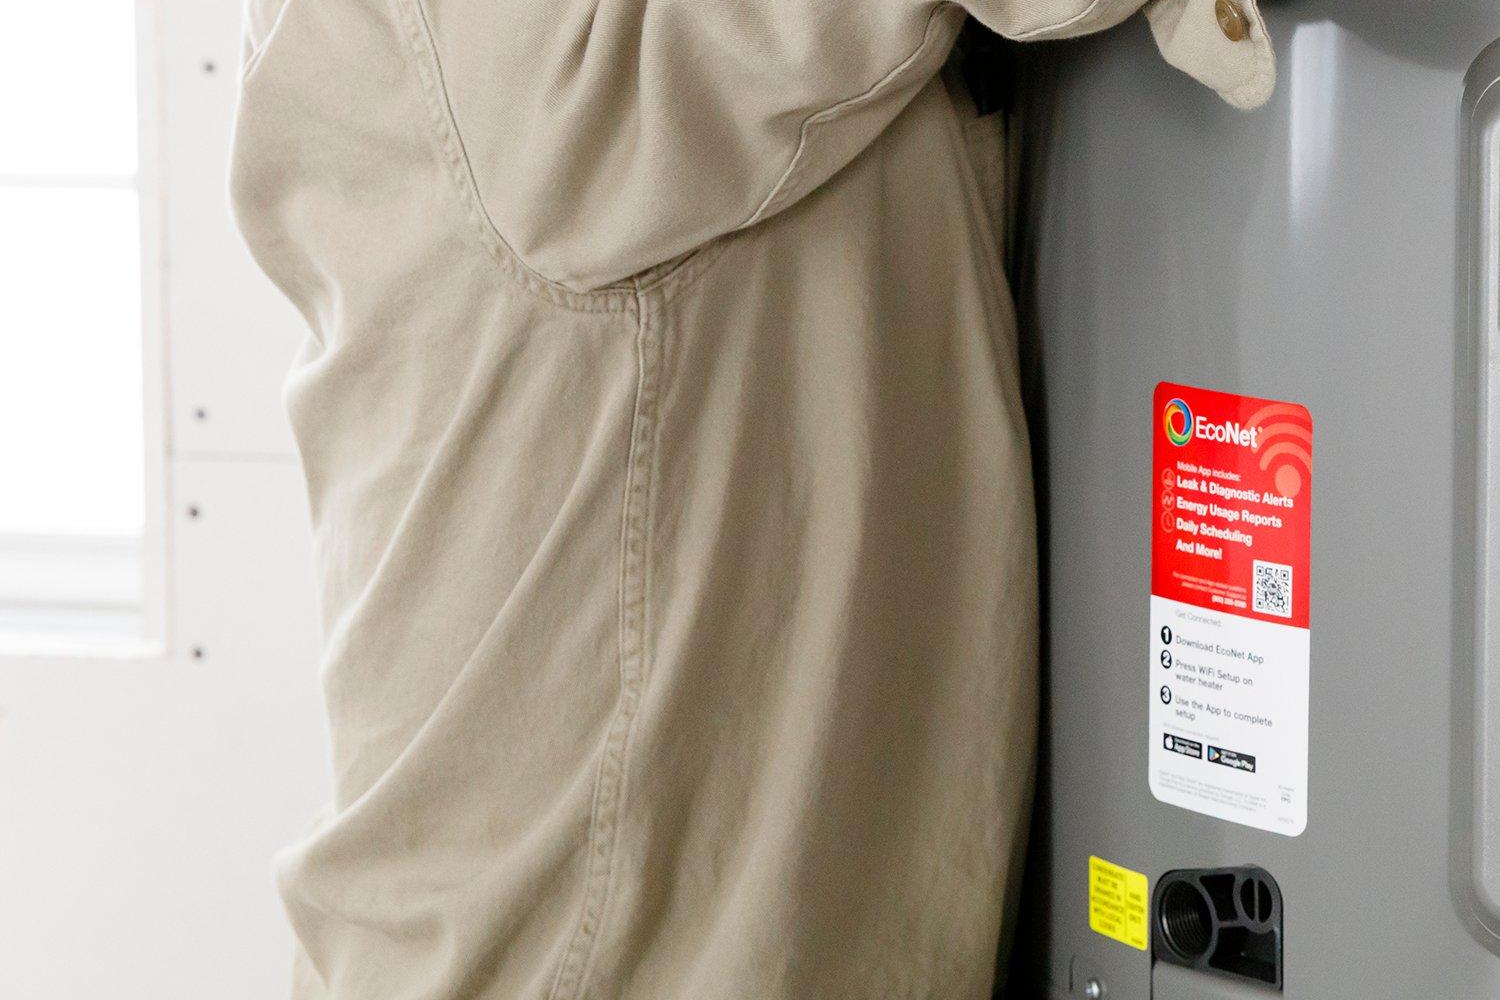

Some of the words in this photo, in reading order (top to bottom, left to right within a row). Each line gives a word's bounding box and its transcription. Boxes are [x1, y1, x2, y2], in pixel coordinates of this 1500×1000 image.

[1195, 416, 1258, 448] EcoNet
[1176, 461, 1198, 474] Mobile
[1199, 465, 1211, 477] App
[1176, 475, 1199, 491] Leak
[1200, 480, 1207, 492] &
[1209, 482, 1261, 502] Diagnostic
[1262, 492, 1294, 508] Alerts
[1176, 496, 1208, 516] Energy
[1209, 501, 1240, 521] Usage
[1241, 510, 1282, 528] Reports
[1176, 517, 1199, 536] Daily
[1199, 522, 1253, 547] Scheduling
[1176, 539, 1194, 553] And
[1195, 543, 1222, 560] More!
[1176, 635, 1213, 653] Download
[1216, 644, 1245, 660] EcoNet
[1247, 652, 1264, 664] App
[1175, 659, 1196, 673] Press
[1199, 664, 1215, 677] WiFi
[1217, 669, 1240, 684] Setup
[1243, 677, 1253, 686] on
[1175, 673, 1197, 685] water
[1198, 676, 1223, 691] heater
[1175, 695, 1189, 708] Use
[1191, 698, 1203, 711] the
[1205, 704, 1221, 716] App
[1223, 708, 1231, 717] to
[1234, 711, 1273, 728] complete
[1175, 708, 1196, 722] setup
